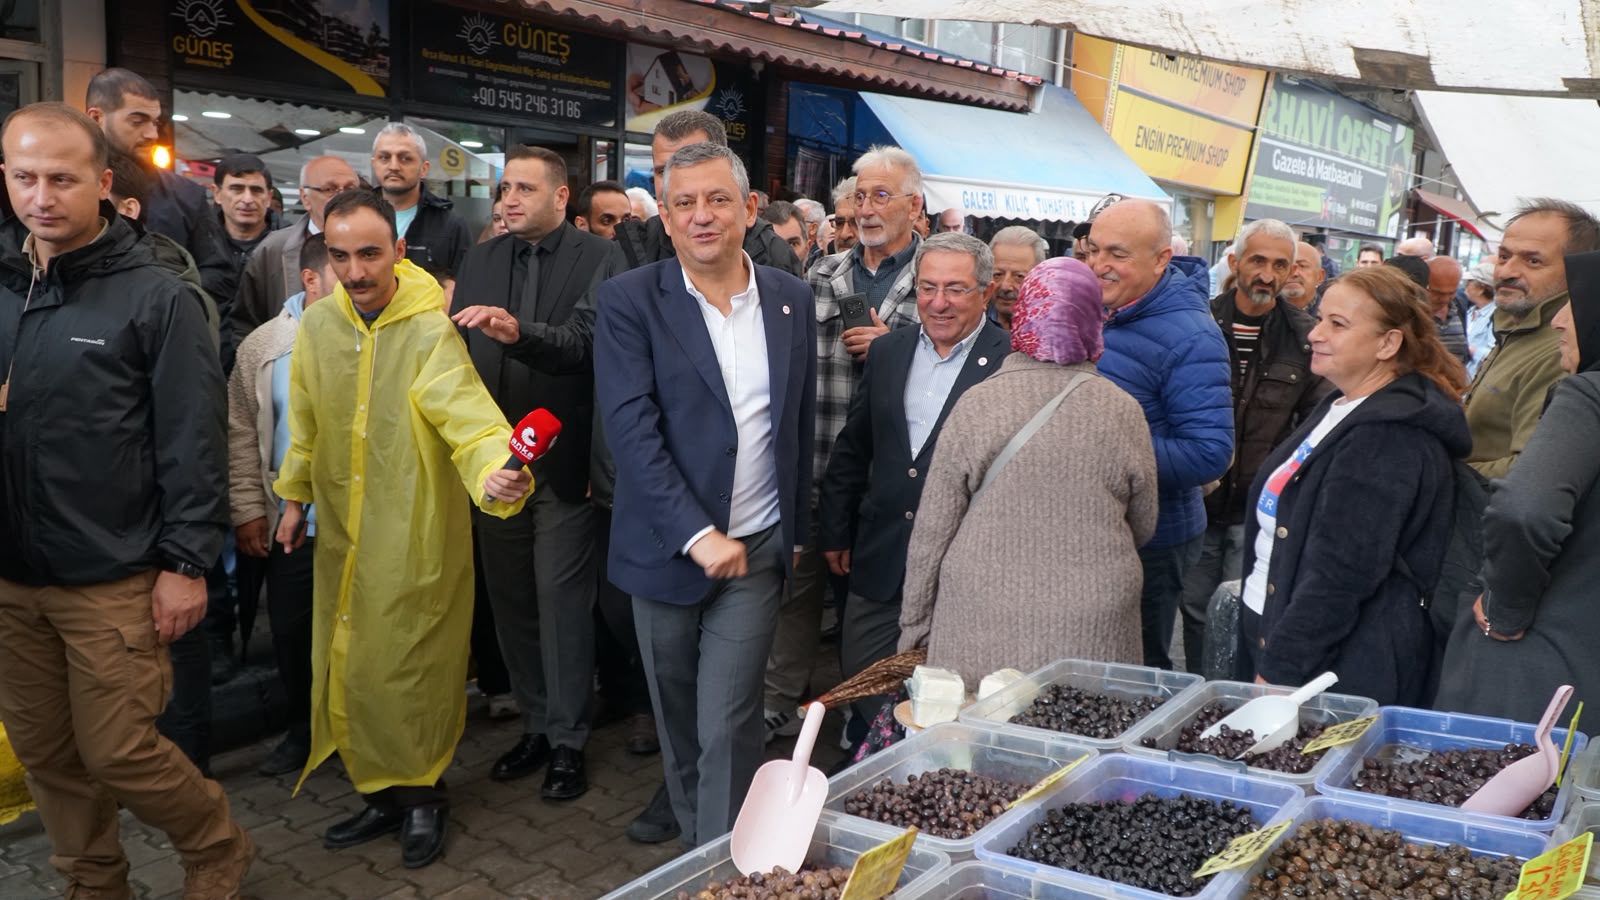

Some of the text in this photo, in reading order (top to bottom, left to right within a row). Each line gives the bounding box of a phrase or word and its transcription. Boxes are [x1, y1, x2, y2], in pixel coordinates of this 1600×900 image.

[173, 34, 234, 66] GÜNEŞ
[503, 21, 571, 64] GÜNEŞ
[1222, 72, 1246, 97] SHOP
[472, 87, 496, 106] +90
[498, 90, 523, 111] 545
[525, 94, 548, 114] 246
[550, 98, 564, 117] 31
[566, 101, 581, 119] 86
[1134, 124, 1230, 169] ENGİN PREMIUM SHOP
[1337, 113, 1391, 170] OFSET
[446, 148, 460, 168] S
[1272, 148, 1306, 176] Gazete
[1306, 157, 1314, 179] &
[1315, 159, 1364, 190] Matbaacılık
[962, 189, 998, 211] GALERİ
[1005, 193, 1030, 216] KILIÇ
